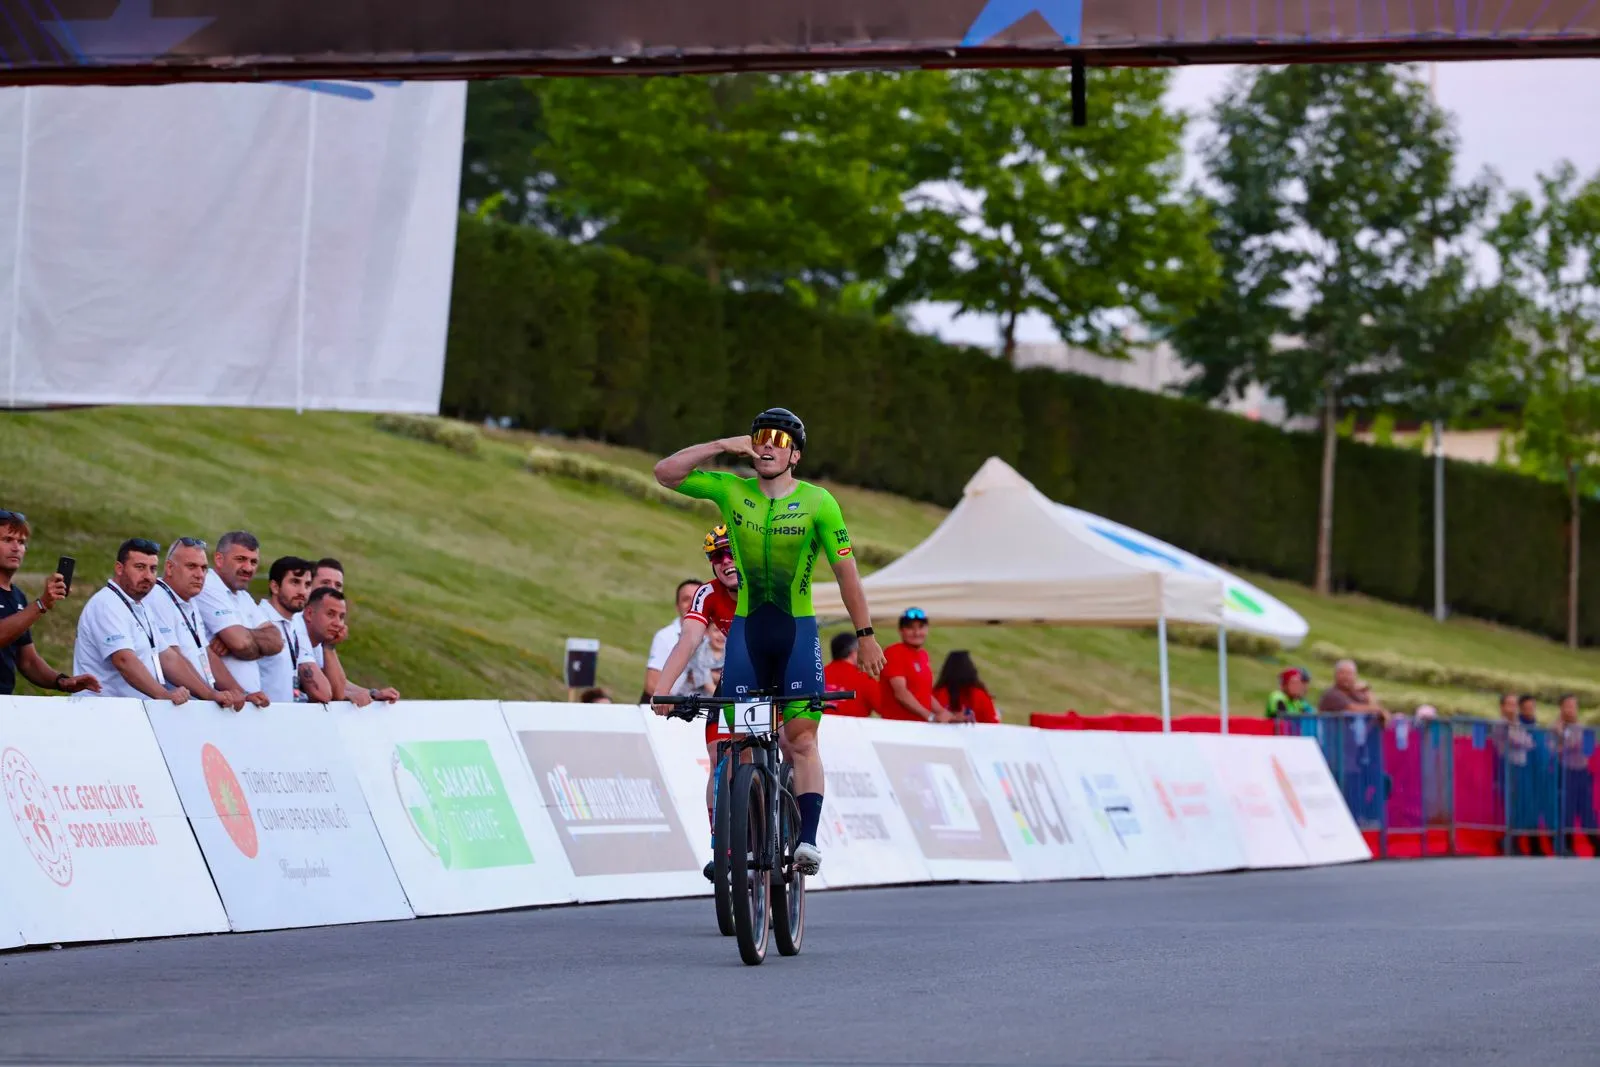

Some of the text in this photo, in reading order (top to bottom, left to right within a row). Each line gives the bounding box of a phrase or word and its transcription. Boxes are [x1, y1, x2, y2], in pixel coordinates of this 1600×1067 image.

[772, 513, 809, 521] DMT
[815, 637, 823, 683] SLOVENIA
[749, 707, 755, 722] 1
[53, 779, 144, 816] T.C. GENÇLİK VE
[433, 764, 497, 798] SAKARYA
[1002, 761, 1074, 846] UCI
[68, 816, 158, 848] SPOR BAKANLIĞI
[448, 802, 504, 841] TÜRKİYE
